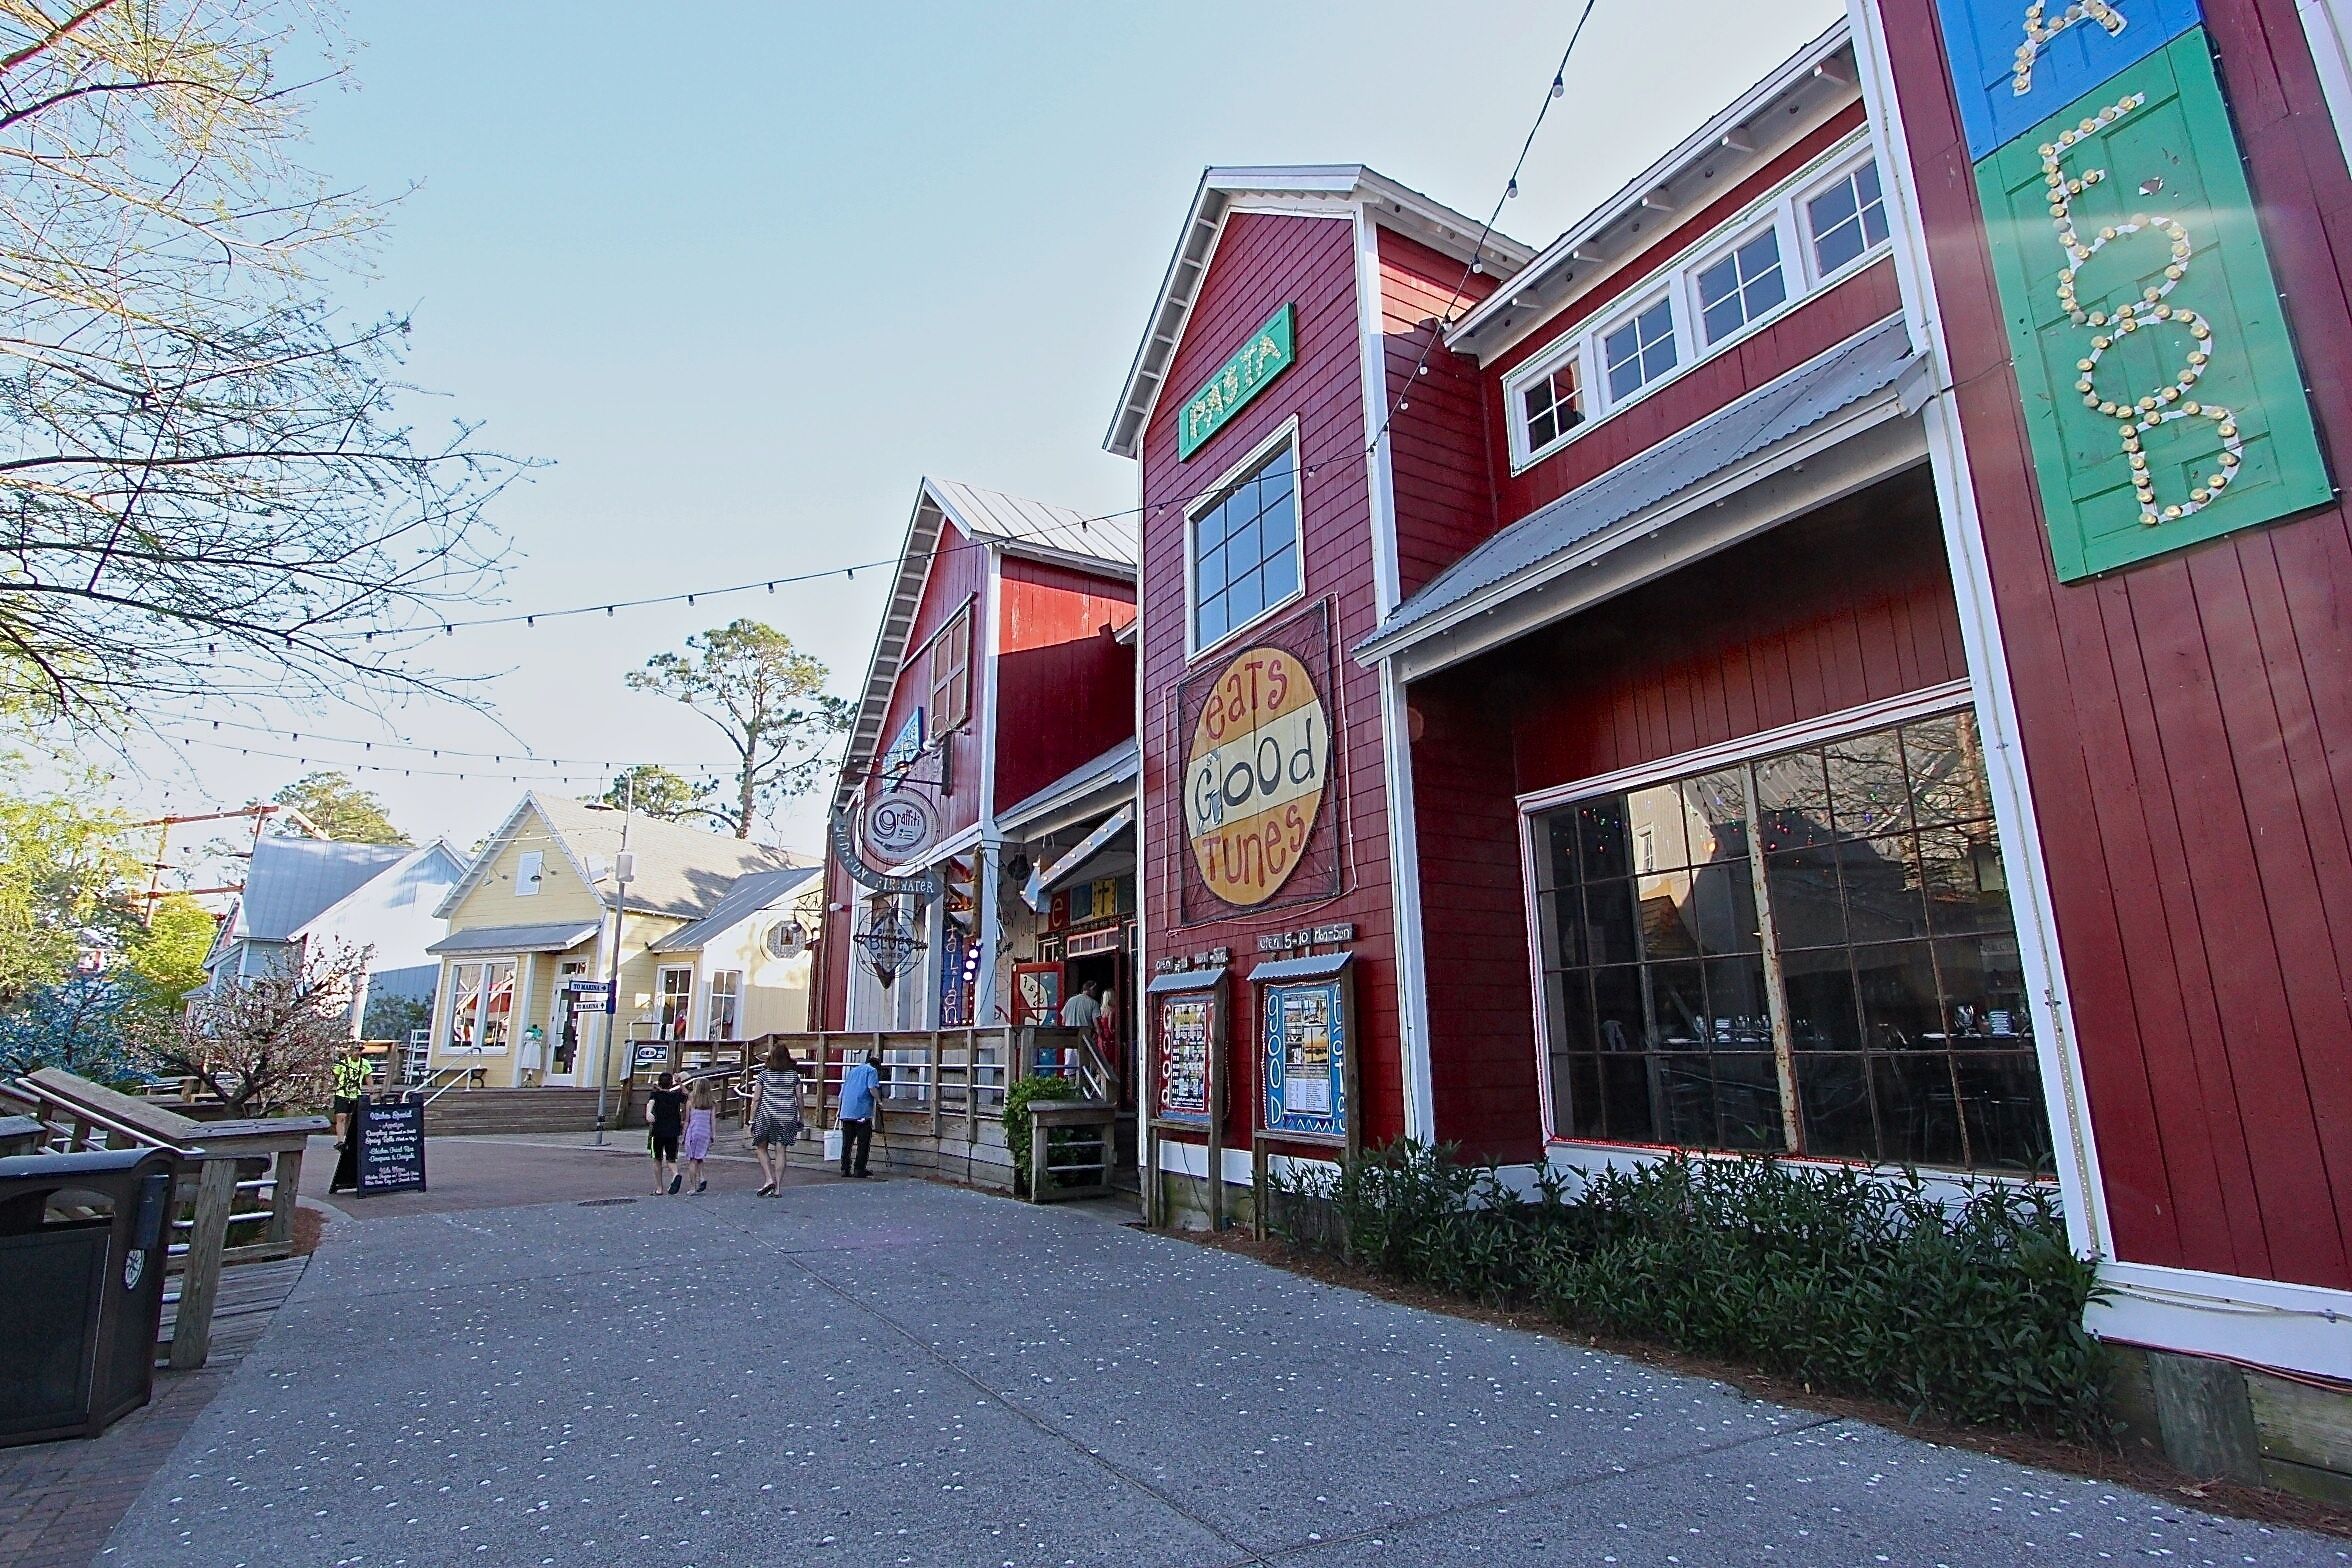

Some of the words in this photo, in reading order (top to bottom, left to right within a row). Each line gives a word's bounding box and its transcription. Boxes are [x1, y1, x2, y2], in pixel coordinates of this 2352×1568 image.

[2038, 91, 2245, 526] FOOD
[1189, 334, 1282, 439] PASTA
[1285, 931, 1308, 949] 5-10
